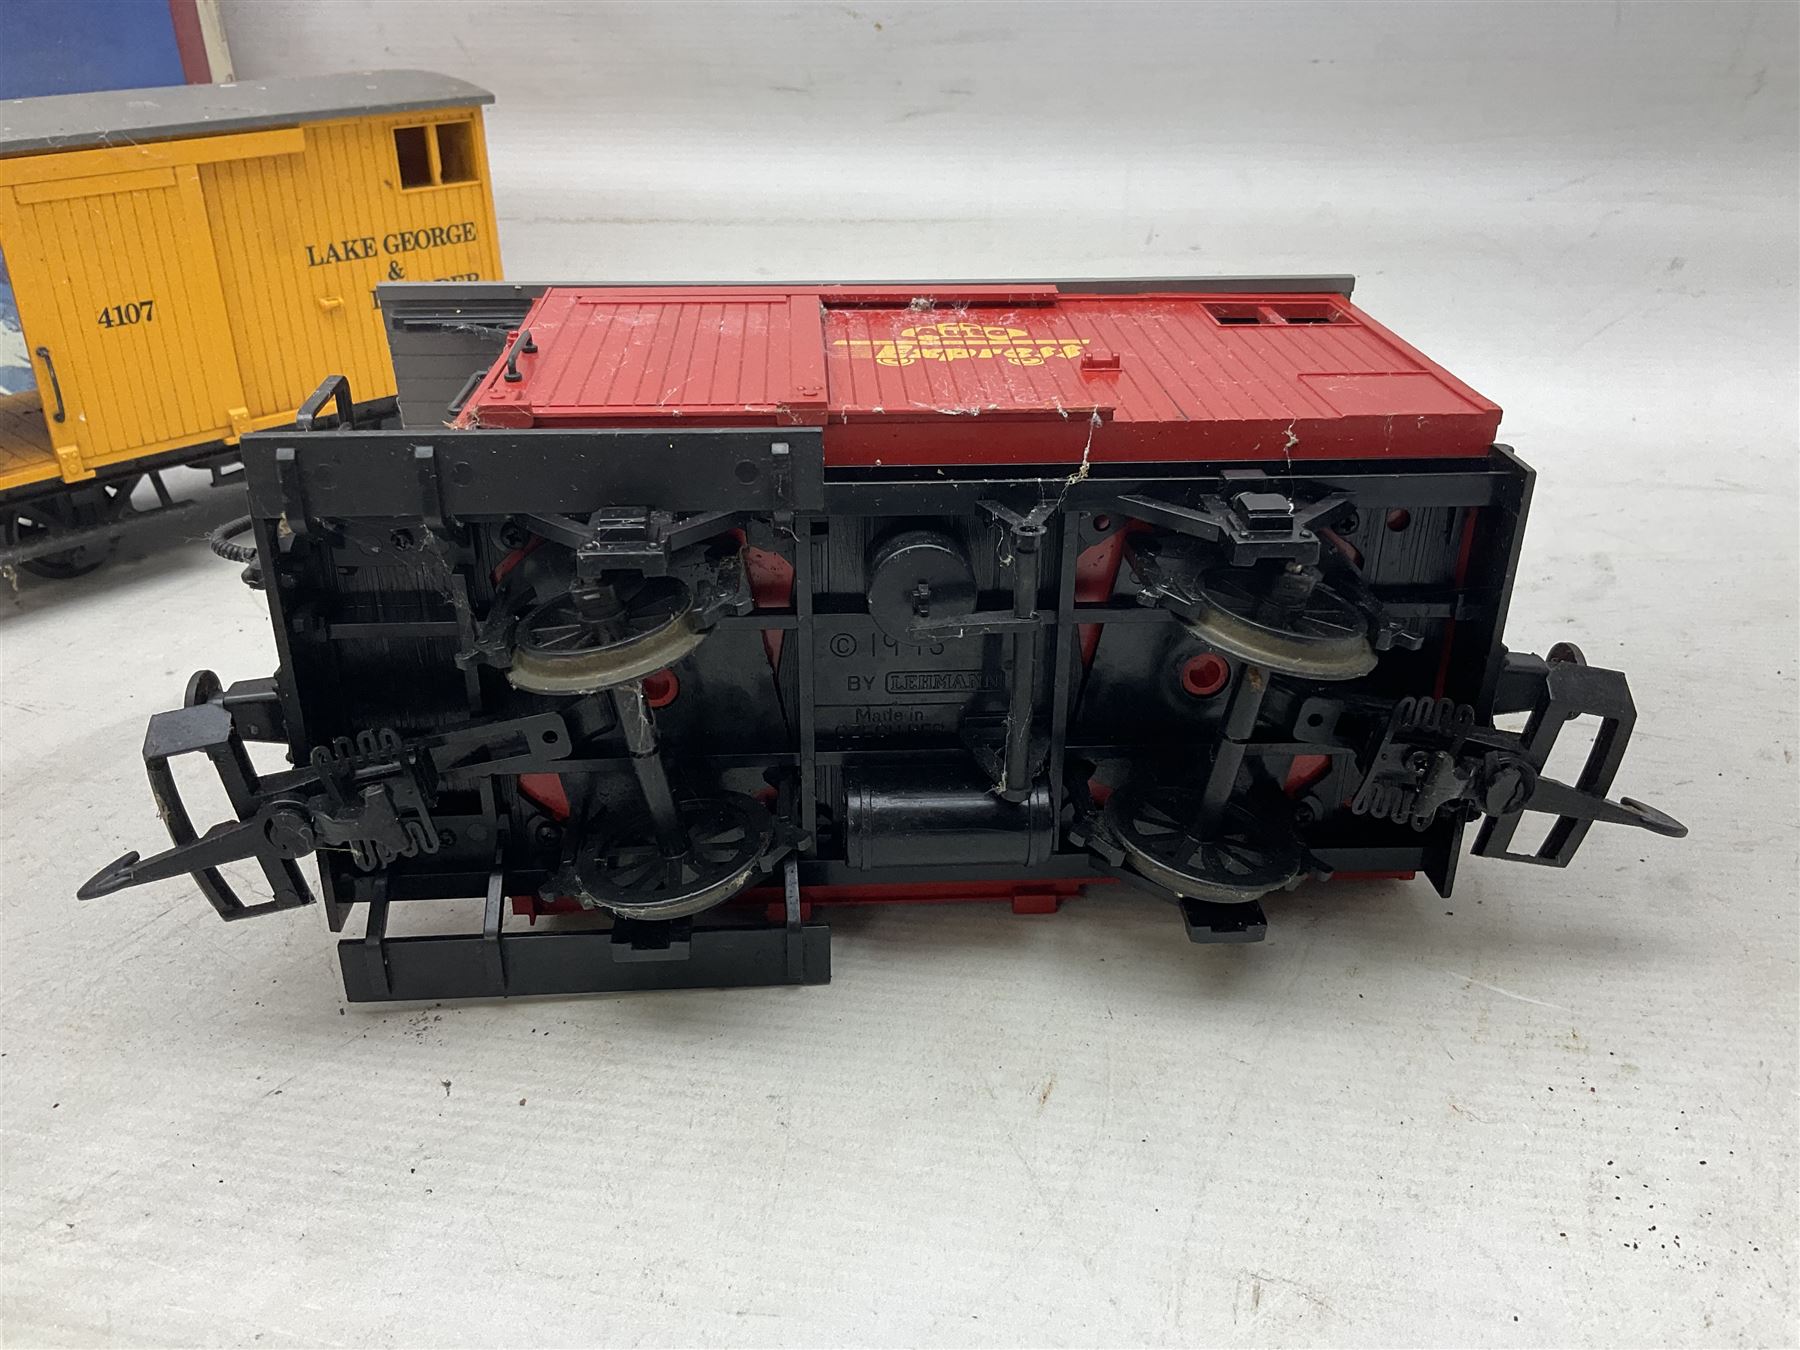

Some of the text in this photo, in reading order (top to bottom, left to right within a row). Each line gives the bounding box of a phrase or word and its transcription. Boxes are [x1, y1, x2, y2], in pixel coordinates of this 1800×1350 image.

[306, 222, 477, 267] LAKE GEORGE
[388, 260, 405, 281] &
[97, 300, 154, 328] 4107
[847, 675, 875, 692] BY
[855, 705, 924, 723] Made in
